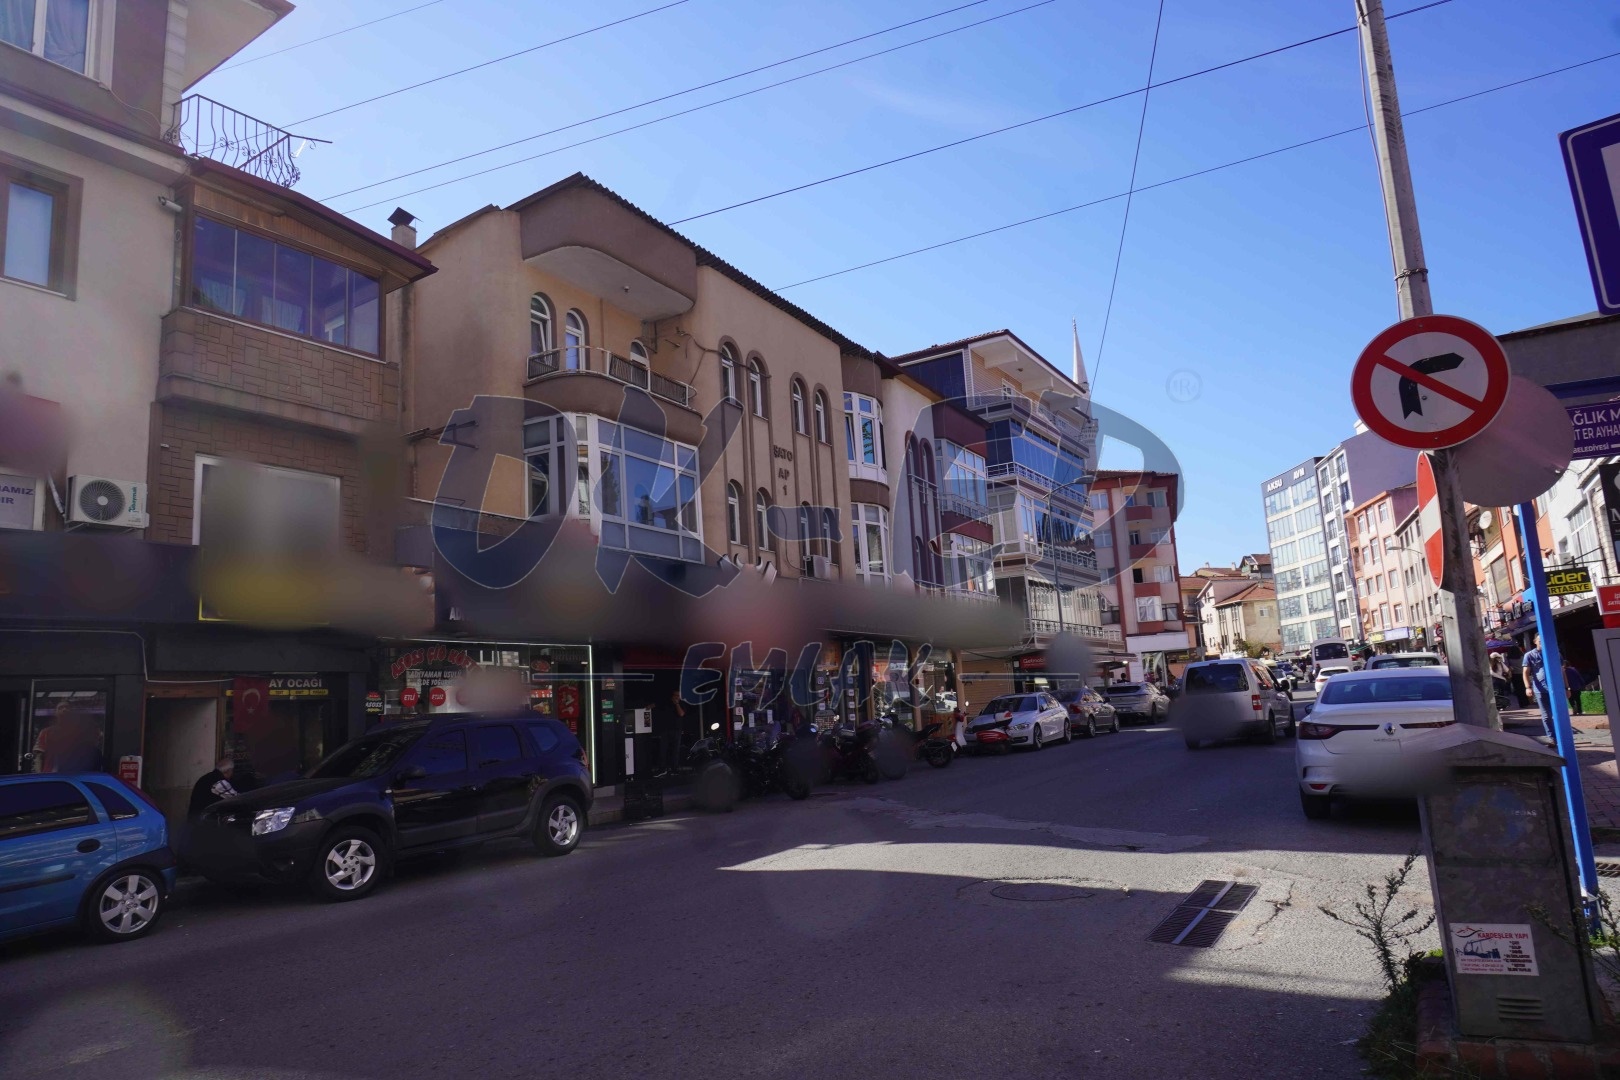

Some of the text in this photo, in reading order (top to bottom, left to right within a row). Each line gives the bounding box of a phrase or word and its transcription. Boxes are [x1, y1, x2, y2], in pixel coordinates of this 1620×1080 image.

[1571, 408, 1620, 426] ĞLIK M
[1596, 424, 1620, 438] AYHA
[0, 485, 34, 496] AMIZ
[0, 497, 14, 505] IR
[268, 678, 285, 688] AY
